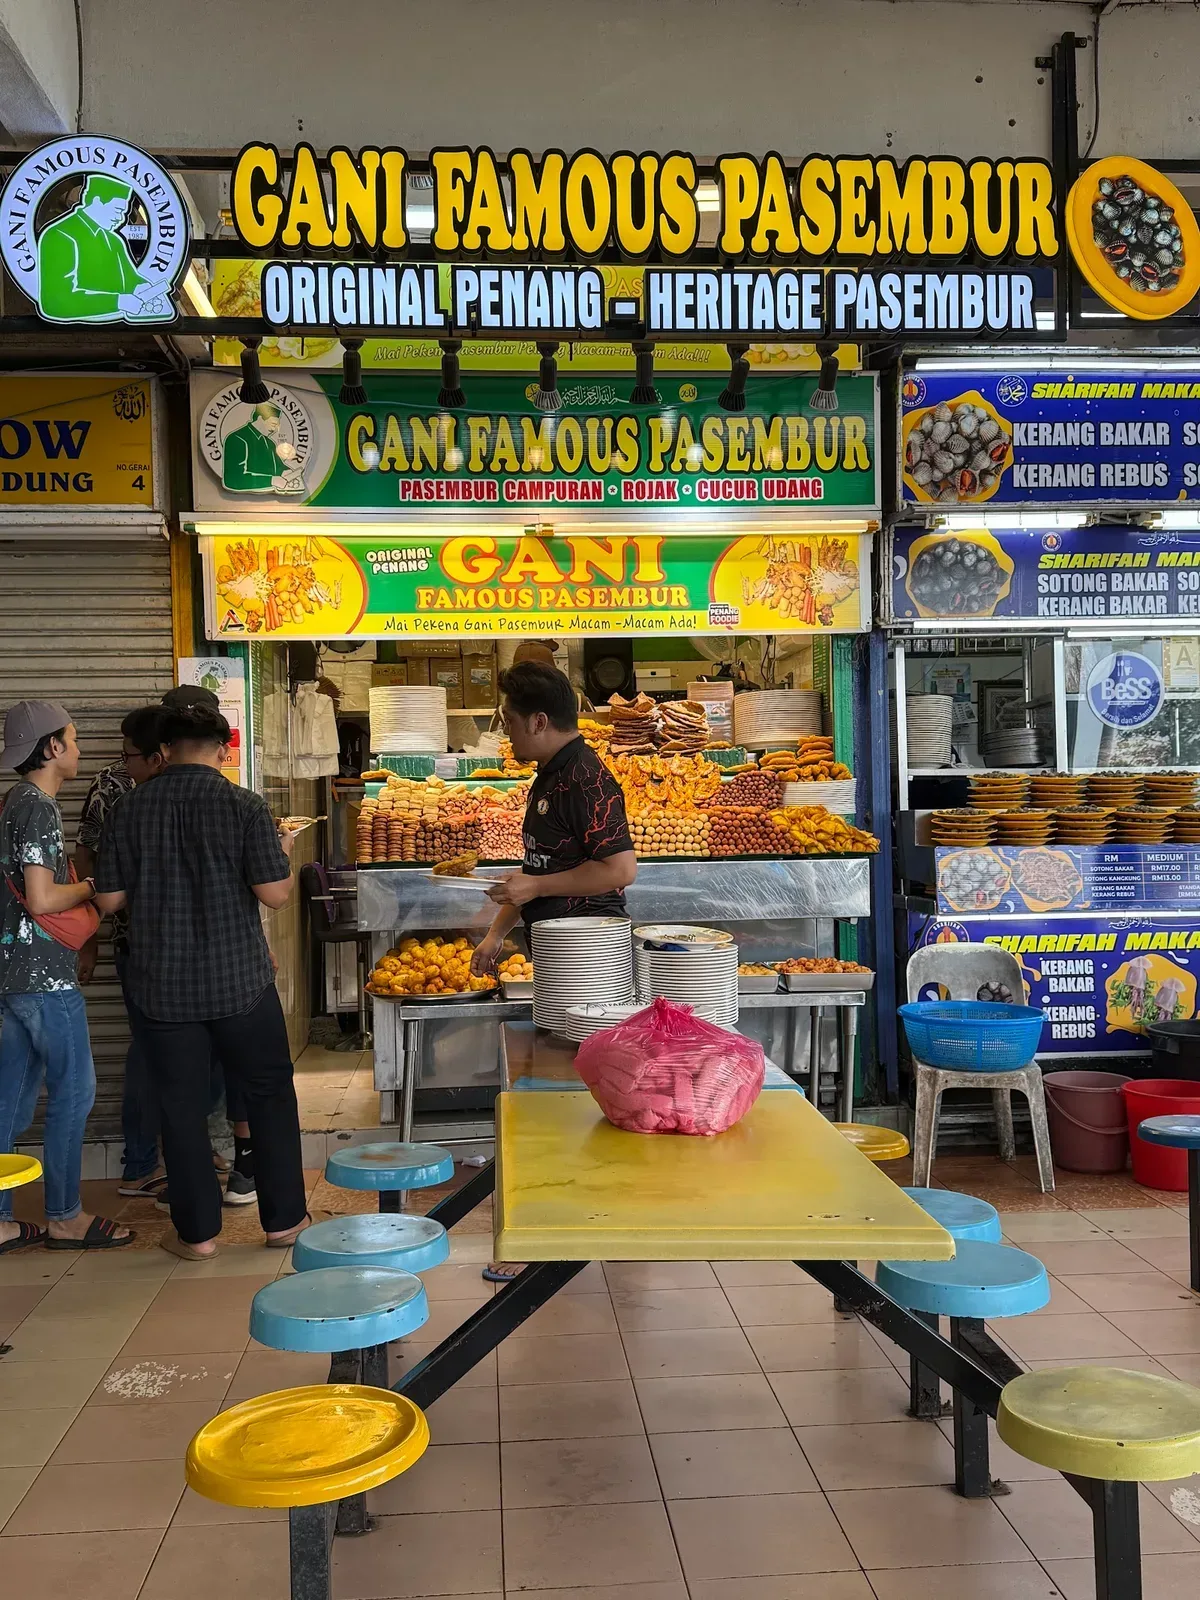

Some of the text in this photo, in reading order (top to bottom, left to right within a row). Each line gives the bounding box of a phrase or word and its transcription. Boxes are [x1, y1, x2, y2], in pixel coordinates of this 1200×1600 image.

[9, 146, 176, 273] GANI FAMOUS PASEMBUR
[232, 144, 1060, 258] GANI FAMOUS PASEMBUR
[264, 264, 445, 327] ORIGINAL
[455, 267, 602, 329] PENANG
[648, 271, 822, 331] HERITAGE
[834, 271, 1035, 331] PASEMBUR
[374, 347, 400, 361] Mai
[403, 343, 443, 358] Peken
[460, 341, 516, 356] asembur
[668, 346, 711, 362] Ada!!!
[1031, 383, 1137, 399] SHARIFAH
[204, 422, 222, 461] GANI
[270, 388, 308, 463] PASEMBUR
[1013, 421, 1200, 447] KERANG BAKAR S
[347, 414, 871, 473] GANI FAMOUS PASEMBUR
[1, 472, 94, 493] DUNG
[131, 475, 146, 491] 4
[1013, 462, 1200, 488] KERANG REBUS S
[400, 478, 823, 501] PASEMBUR CAMPURAN ROJAK CUCUR UDANG
[365, 547, 433, 563] ORIGINAL
[440, 535, 666, 584] GANI
[1038, 552, 1151, 569] SHARIFAH
[372, 560, 430, 575] PENANG
[1037, 571, 1200, 593] SOTONG BAKAR SO
[417, 587, 689, 609] FAMOUS PASEMBUR
[1037, 594, 1200, 616] KERANG BAKAR KE
[383, 616, 409, 632] Mai
[463, 618, 493, 631] Gani
[568, 615, 611, 630] Macam
[669, 614, 697, 629] Ada!
[710, 615, 739, 624] FOODIE
[1176, 645, 1193, 666] A
[1101, 676, 1152, 701] BeSS
[1133, 703, 1155, 722] Selamat
[1104, 854, 1119, 862] RM
[1147, 853, 1184, 862] MEDIUM
[1151, 864, 1181, 872] RM17.00
[983, 932, 1118, 954] SHARIFAH
[1041, 959, 1094, 976] KERANG
[1049, 976, 1095, 993] BAKAR
[1043, 1006, 1096, 1022] KERANG
[1051, 1023, 1096, 1039] REBUS
